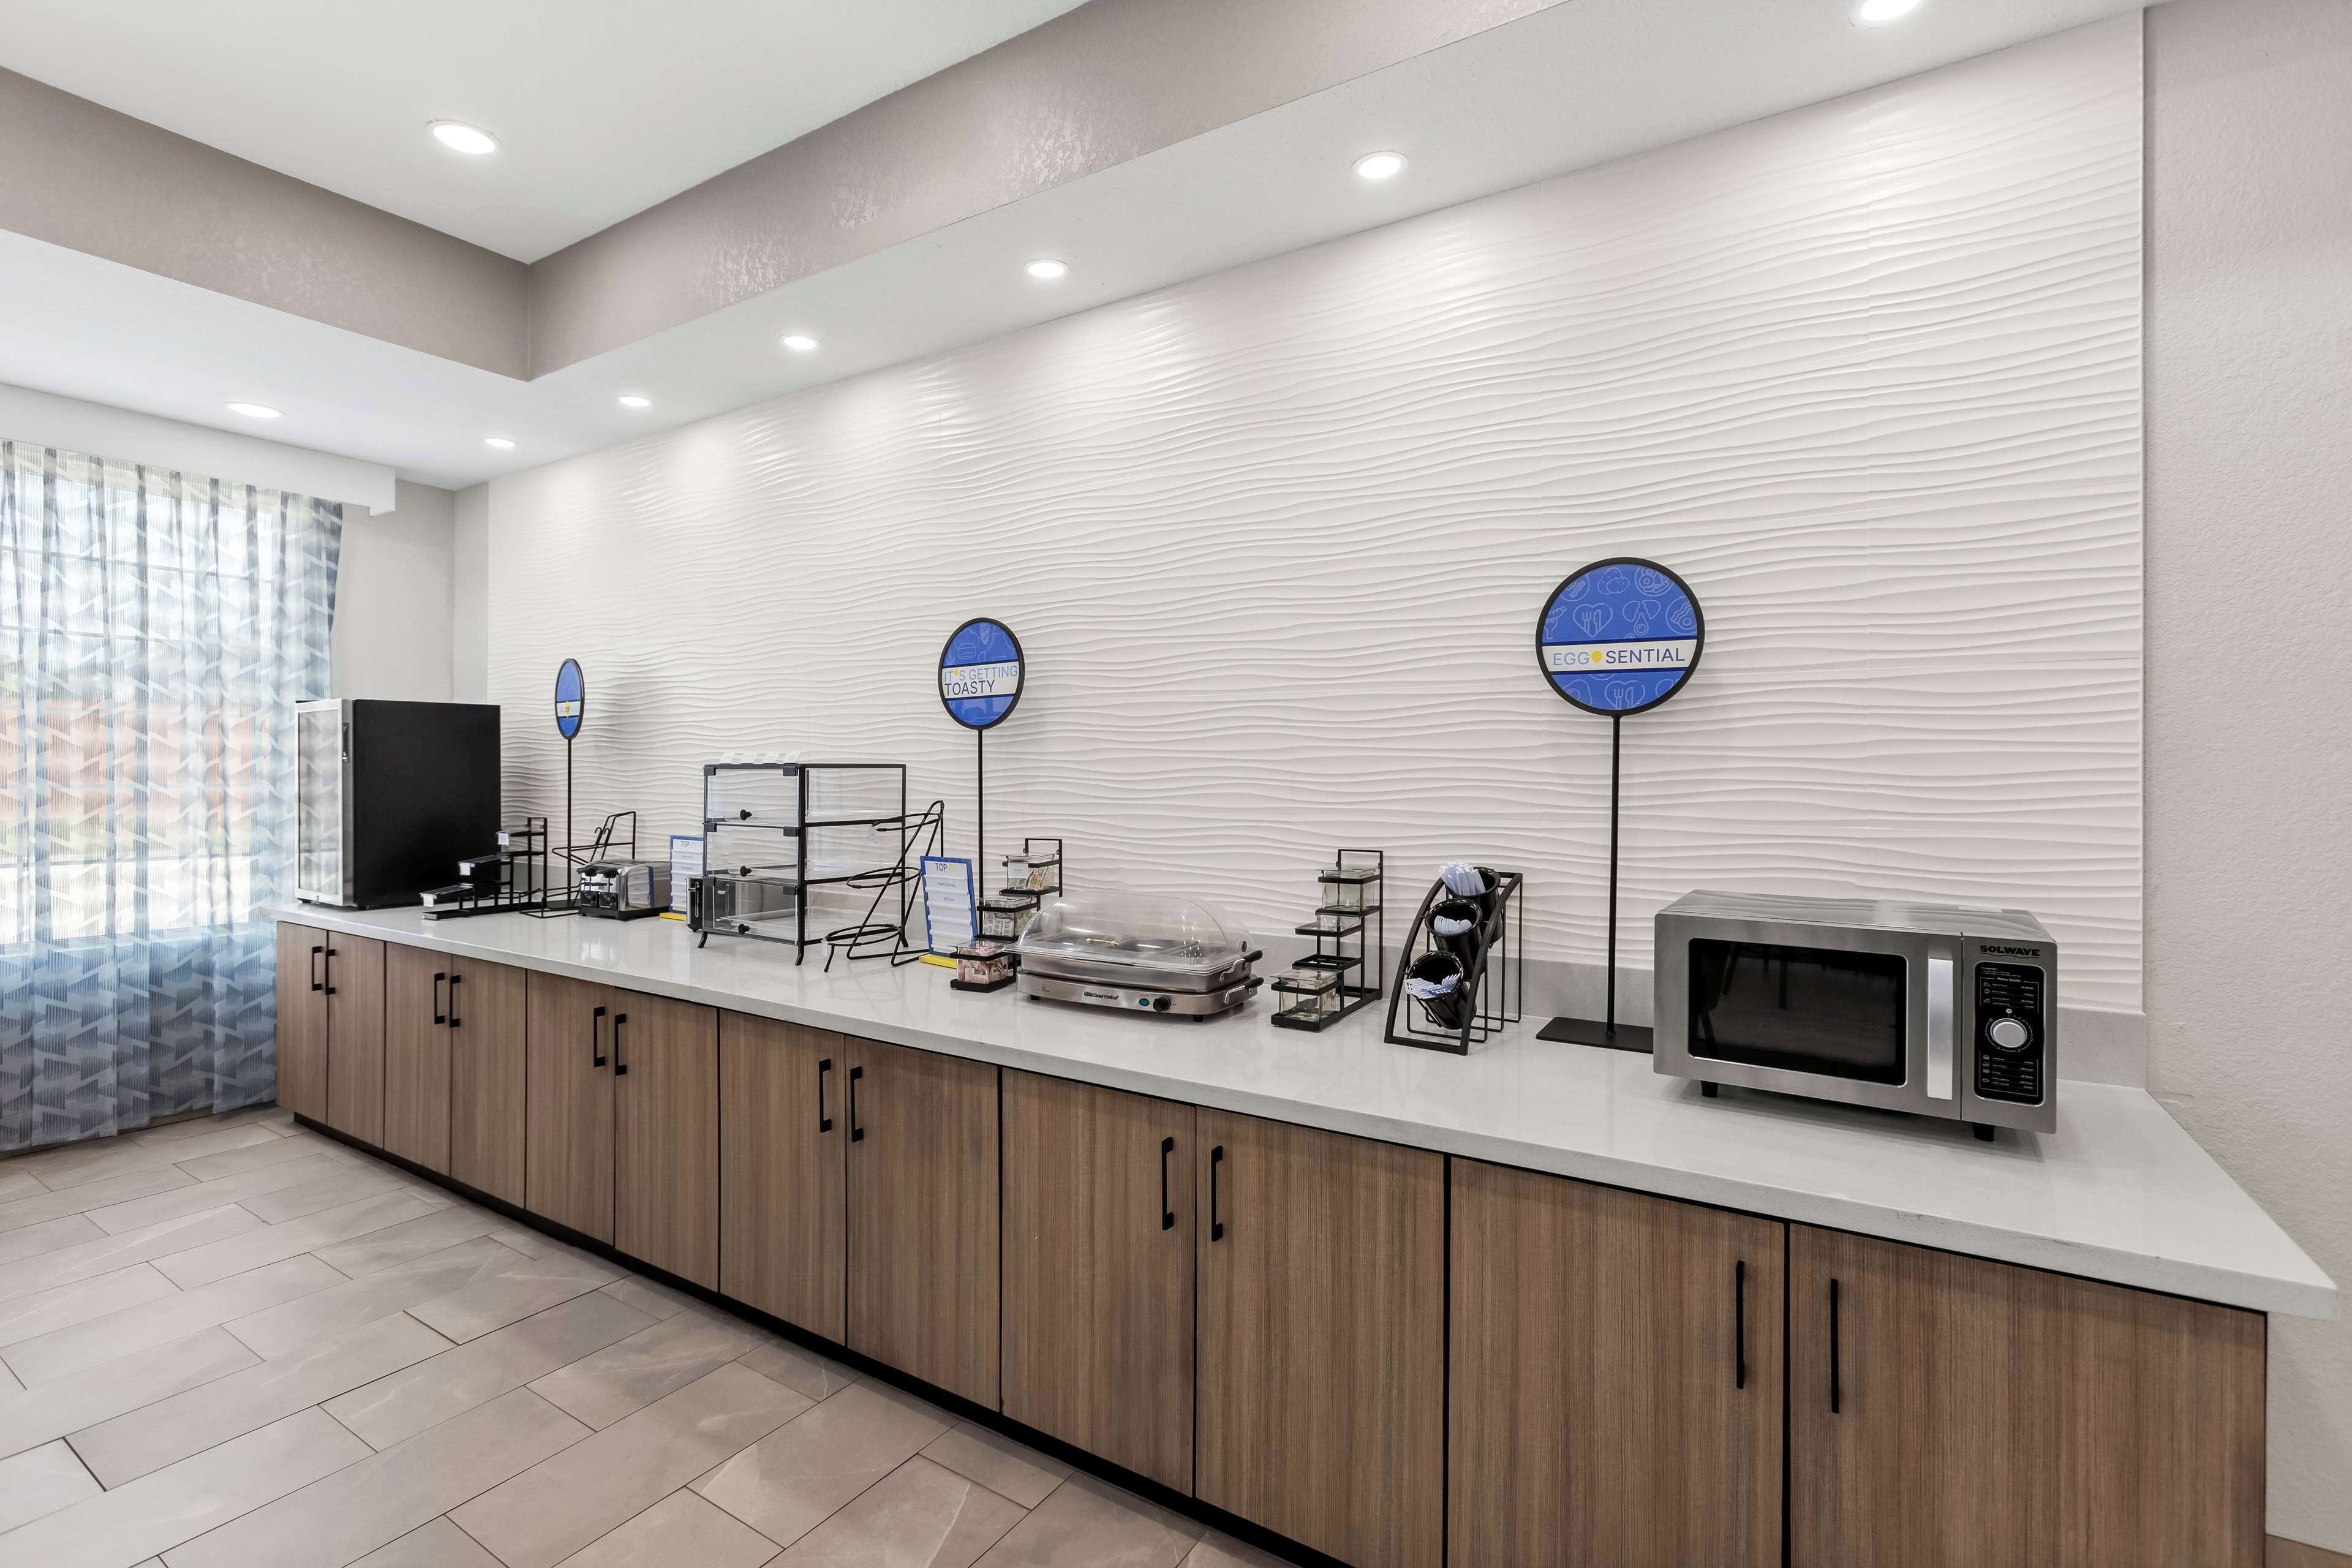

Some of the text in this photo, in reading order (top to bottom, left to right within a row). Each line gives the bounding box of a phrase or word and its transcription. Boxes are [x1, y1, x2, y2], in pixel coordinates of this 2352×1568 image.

[944, 665, 1017, 683] IT'S GETTING
[944, 679, 995, 696] TOASTY
[935, 862, 948, 872] TOP
[1979, 944, 2040, 957] SOLWAVE
